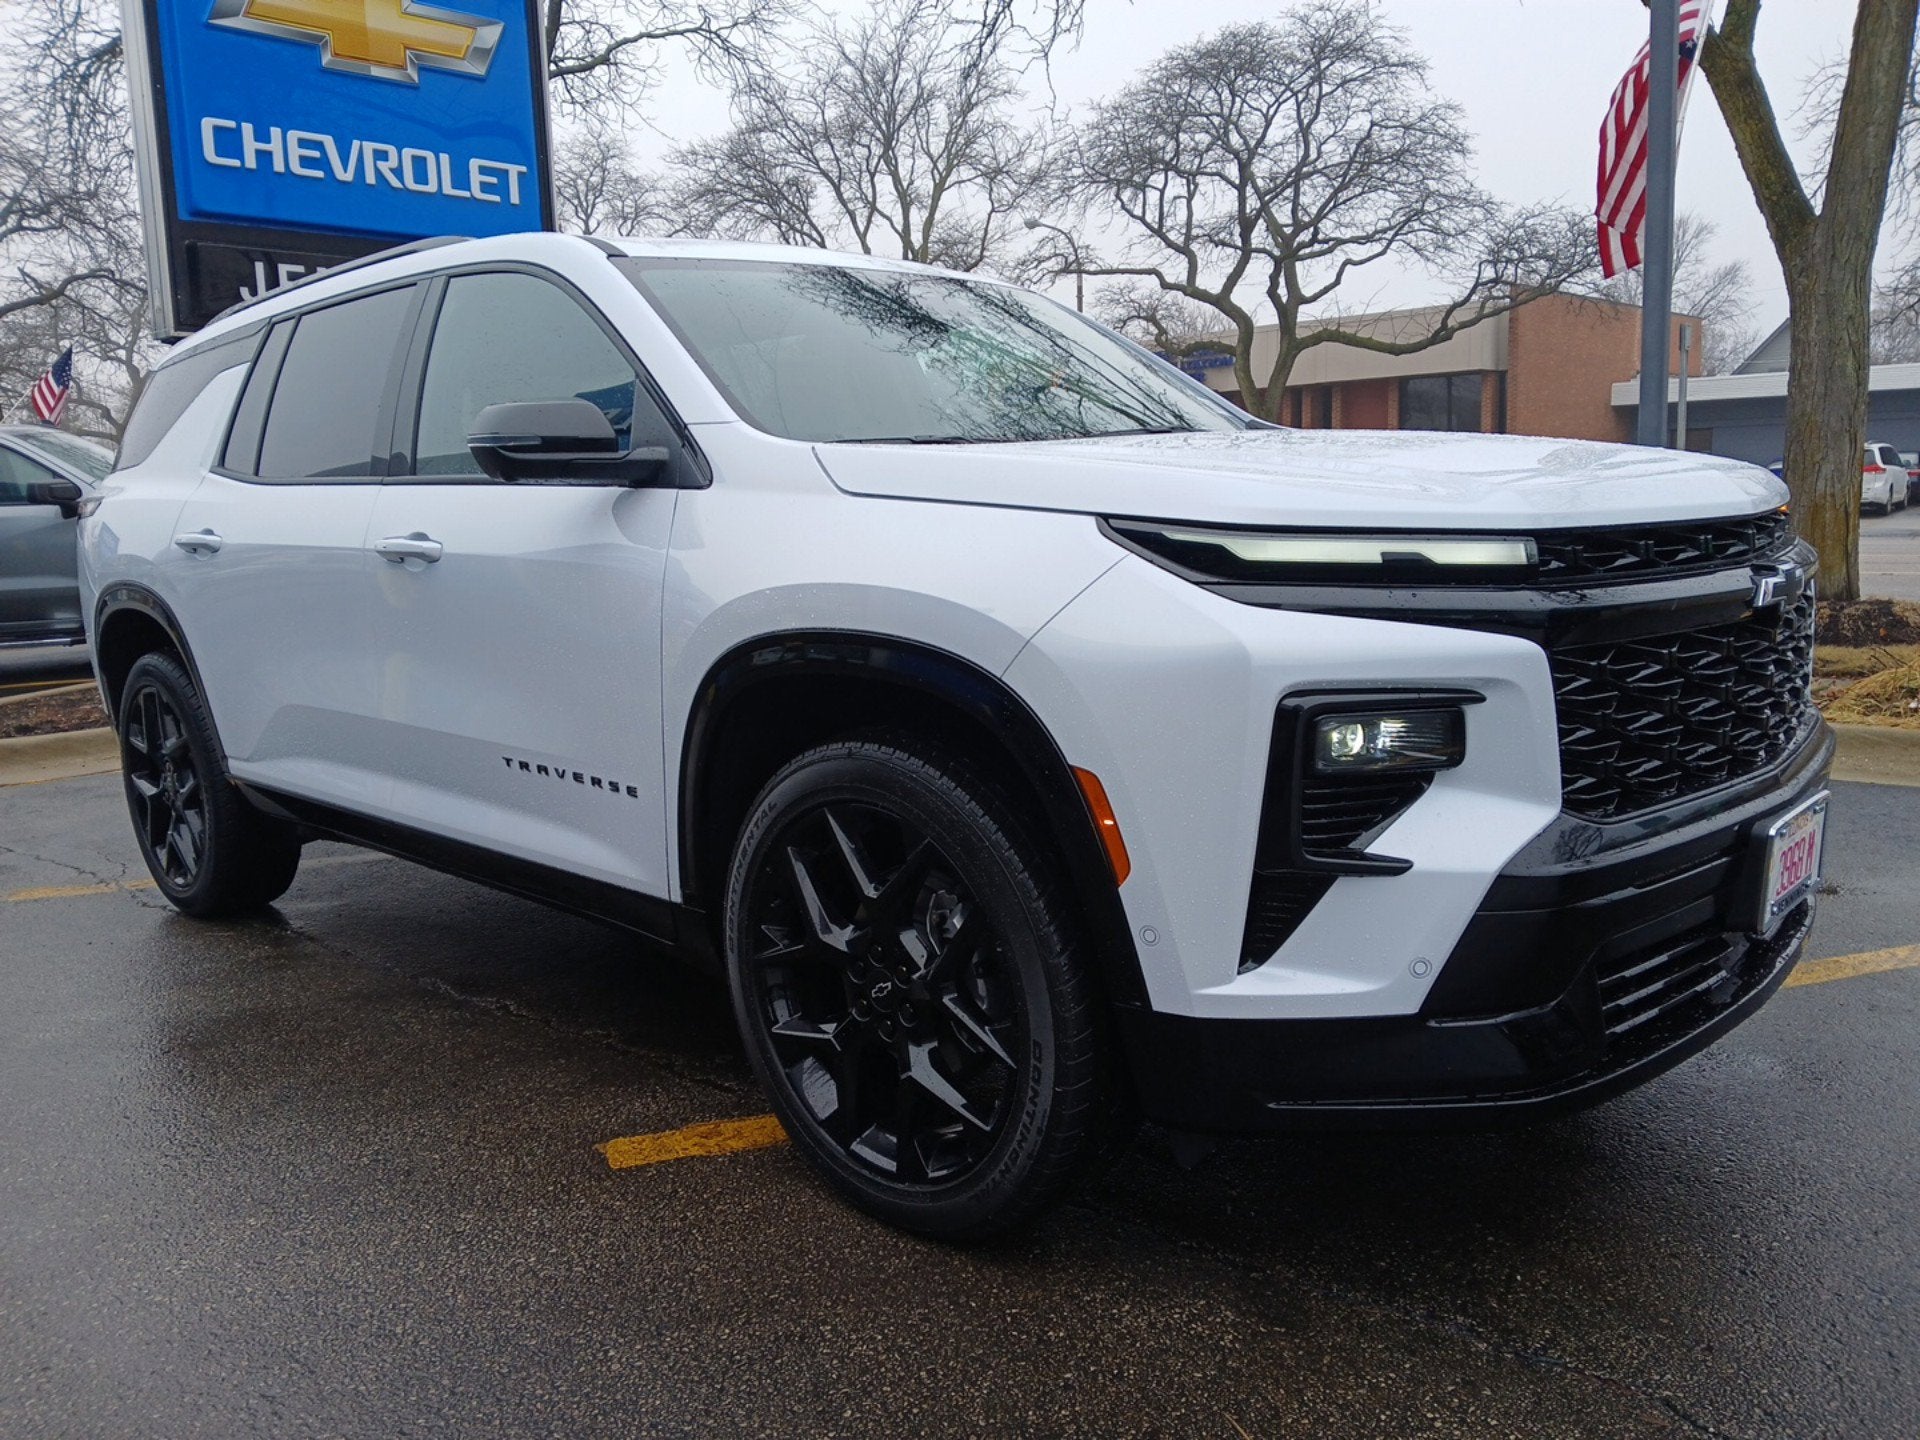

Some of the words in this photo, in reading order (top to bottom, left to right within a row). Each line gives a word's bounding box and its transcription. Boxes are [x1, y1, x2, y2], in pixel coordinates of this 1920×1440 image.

[201, 116, 527, 205] CHEVROLET
[239, 261, 327, 301] JE
[502, 756, 638, 799] TRAVERSE
[974, 1038, 1042, 1202] CONTINENT
